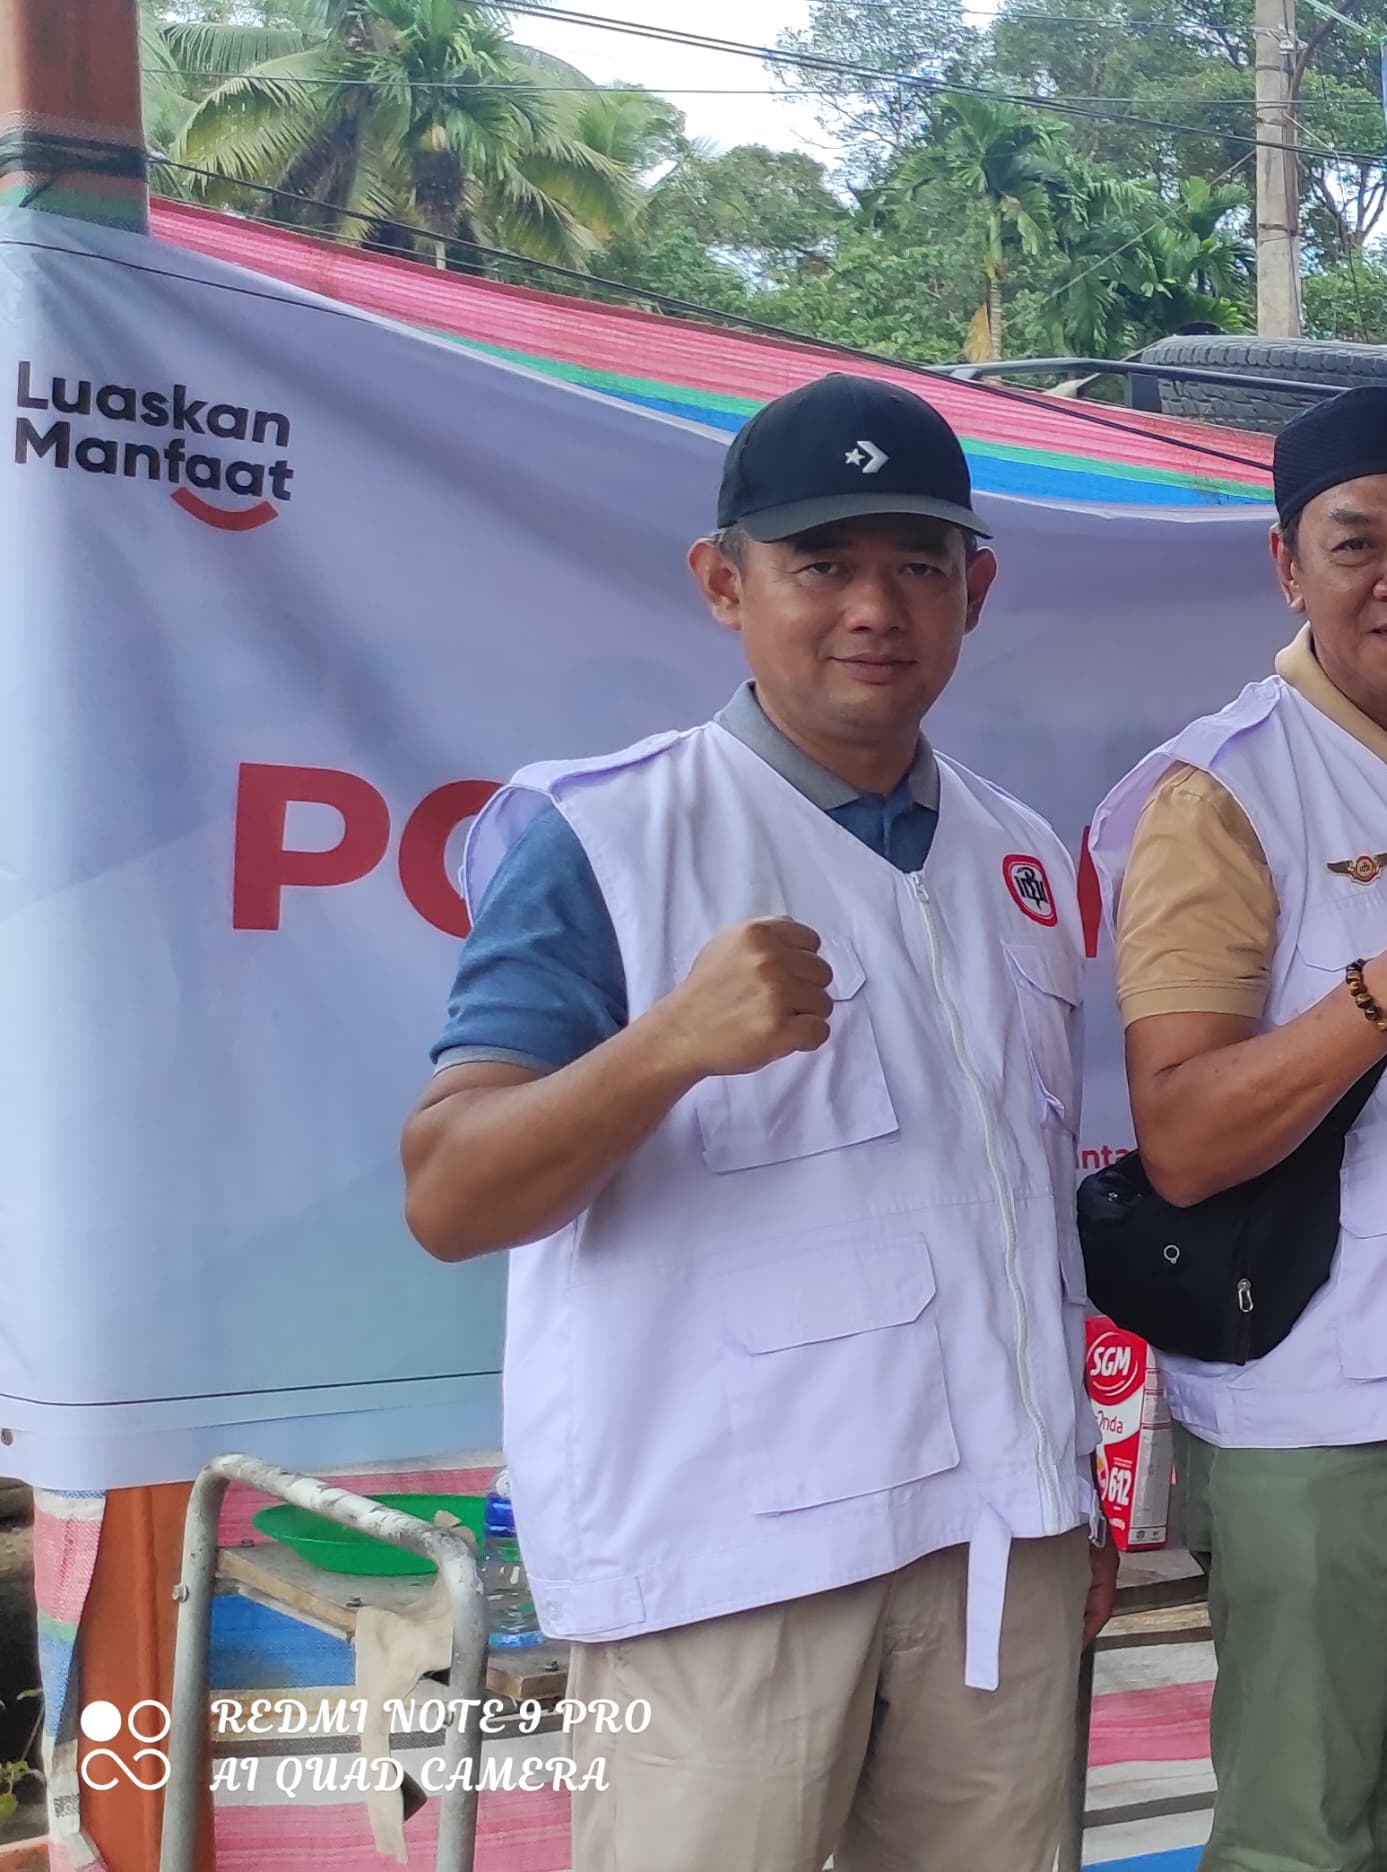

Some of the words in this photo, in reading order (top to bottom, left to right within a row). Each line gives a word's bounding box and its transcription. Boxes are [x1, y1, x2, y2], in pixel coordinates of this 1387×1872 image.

[15, 360, 290, 448] Luaskan
[14, 417, 293, 502] Manfaat
[1090, 1346, 1131, 1377] SGM
